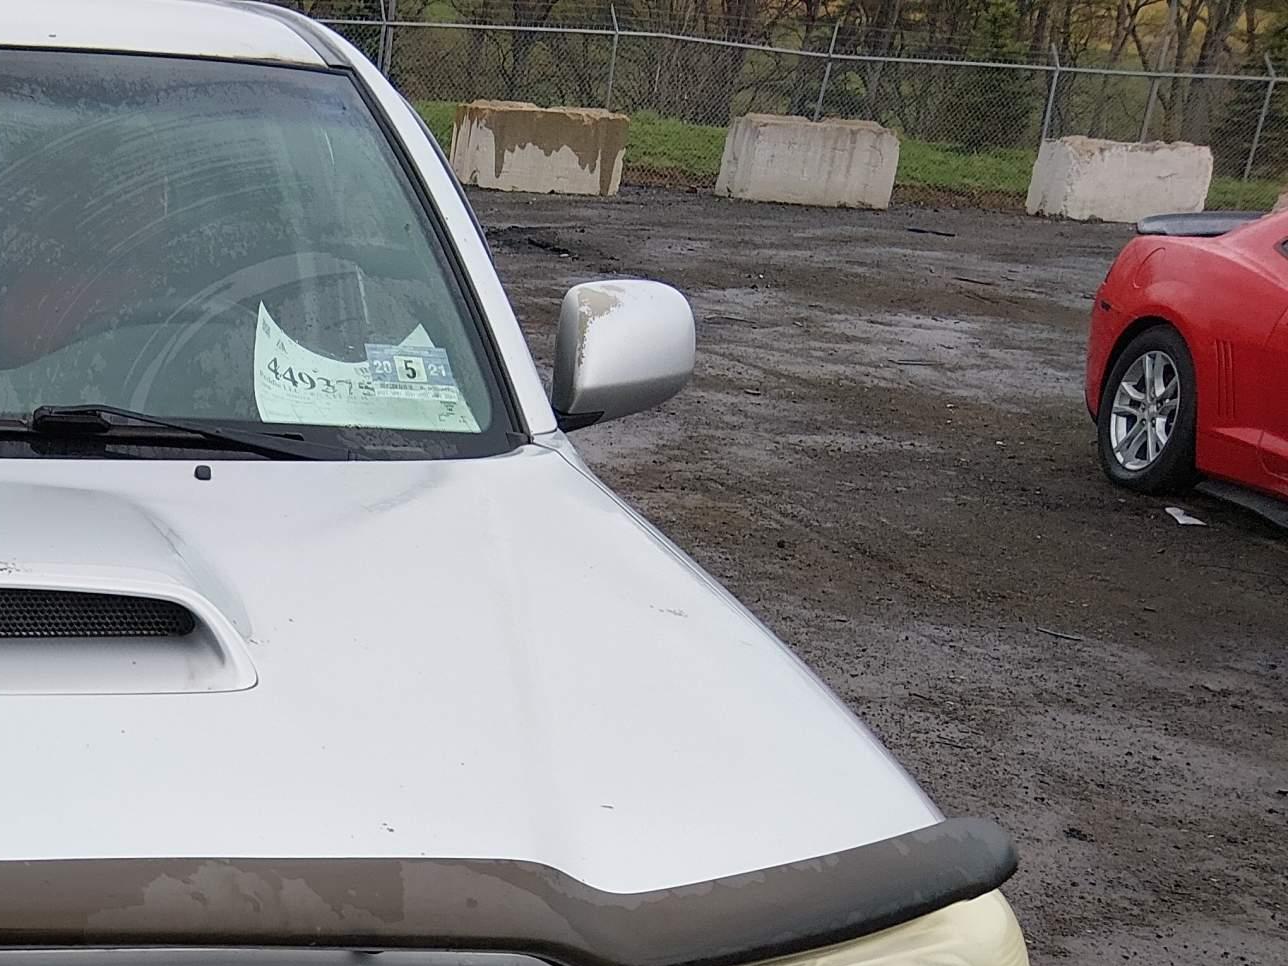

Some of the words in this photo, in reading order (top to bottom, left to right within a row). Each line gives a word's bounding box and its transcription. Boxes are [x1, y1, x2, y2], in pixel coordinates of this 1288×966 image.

[373, 360, 392, 374] 20
[404, 359, 417, 379] 5
[428, 364, 447, 378] 21
